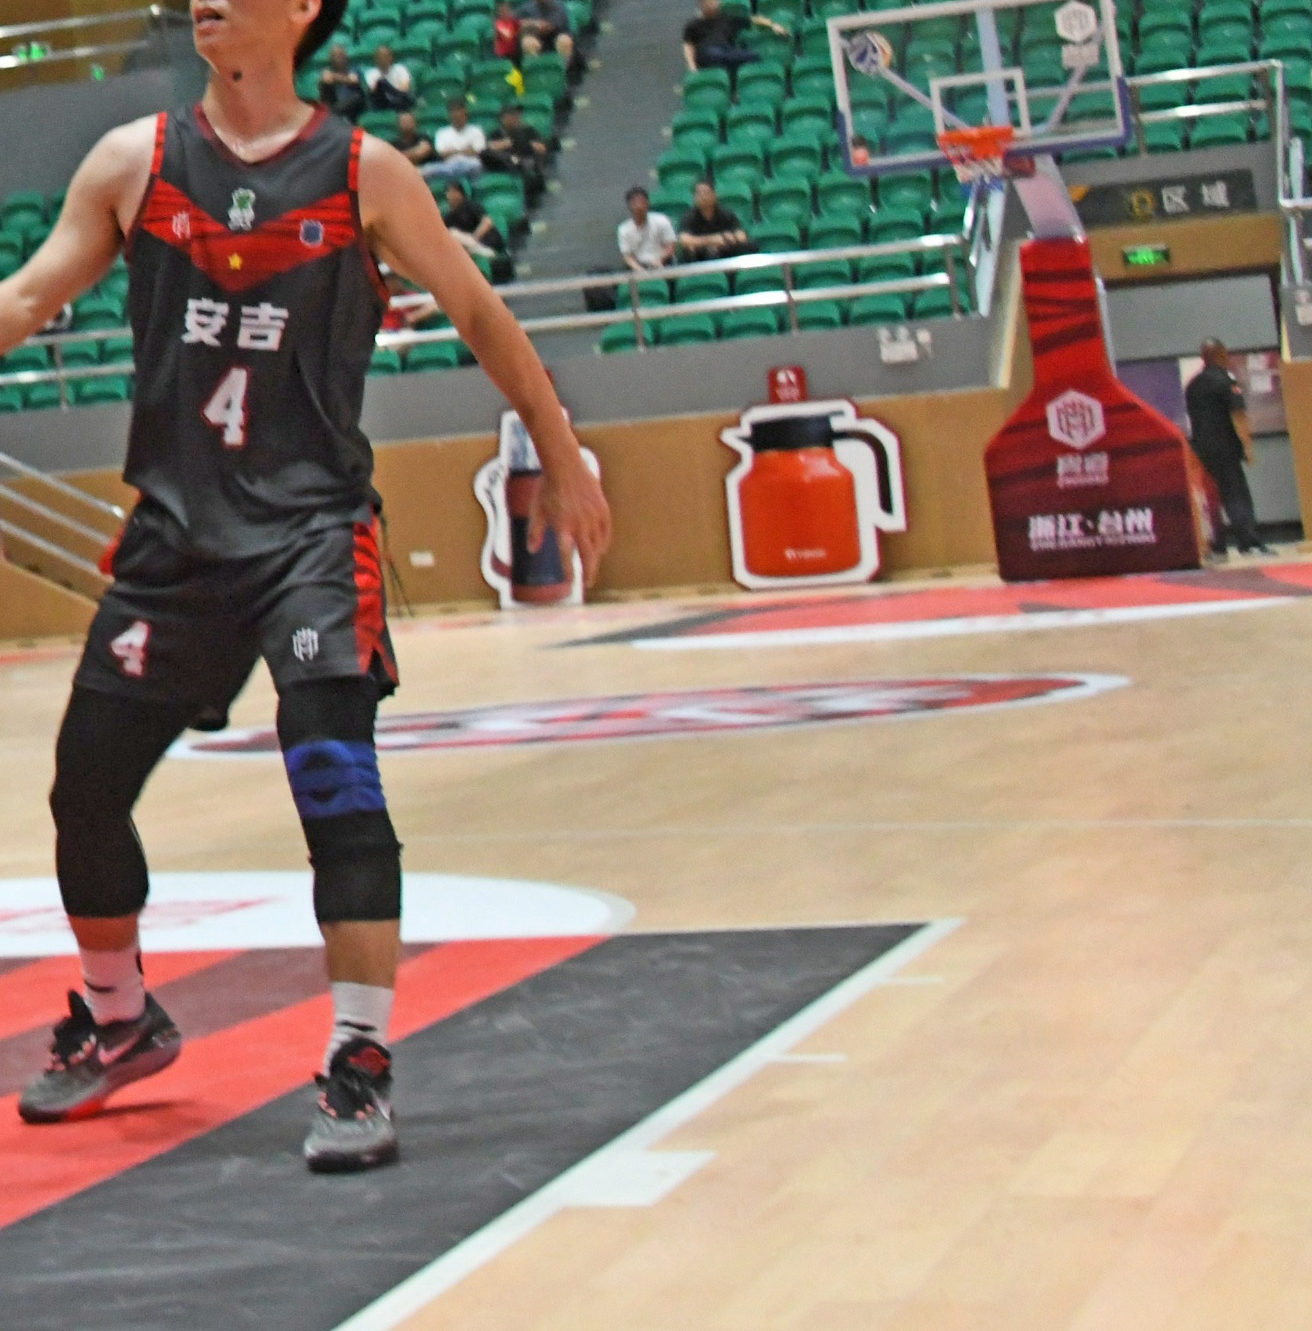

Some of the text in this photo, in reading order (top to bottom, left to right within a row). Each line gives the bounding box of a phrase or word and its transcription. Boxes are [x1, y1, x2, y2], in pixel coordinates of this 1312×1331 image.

[180, 297, 289, 352] 安吉
[201, 365, 249, 448] 4
[111, 620, 150, 676] 4
